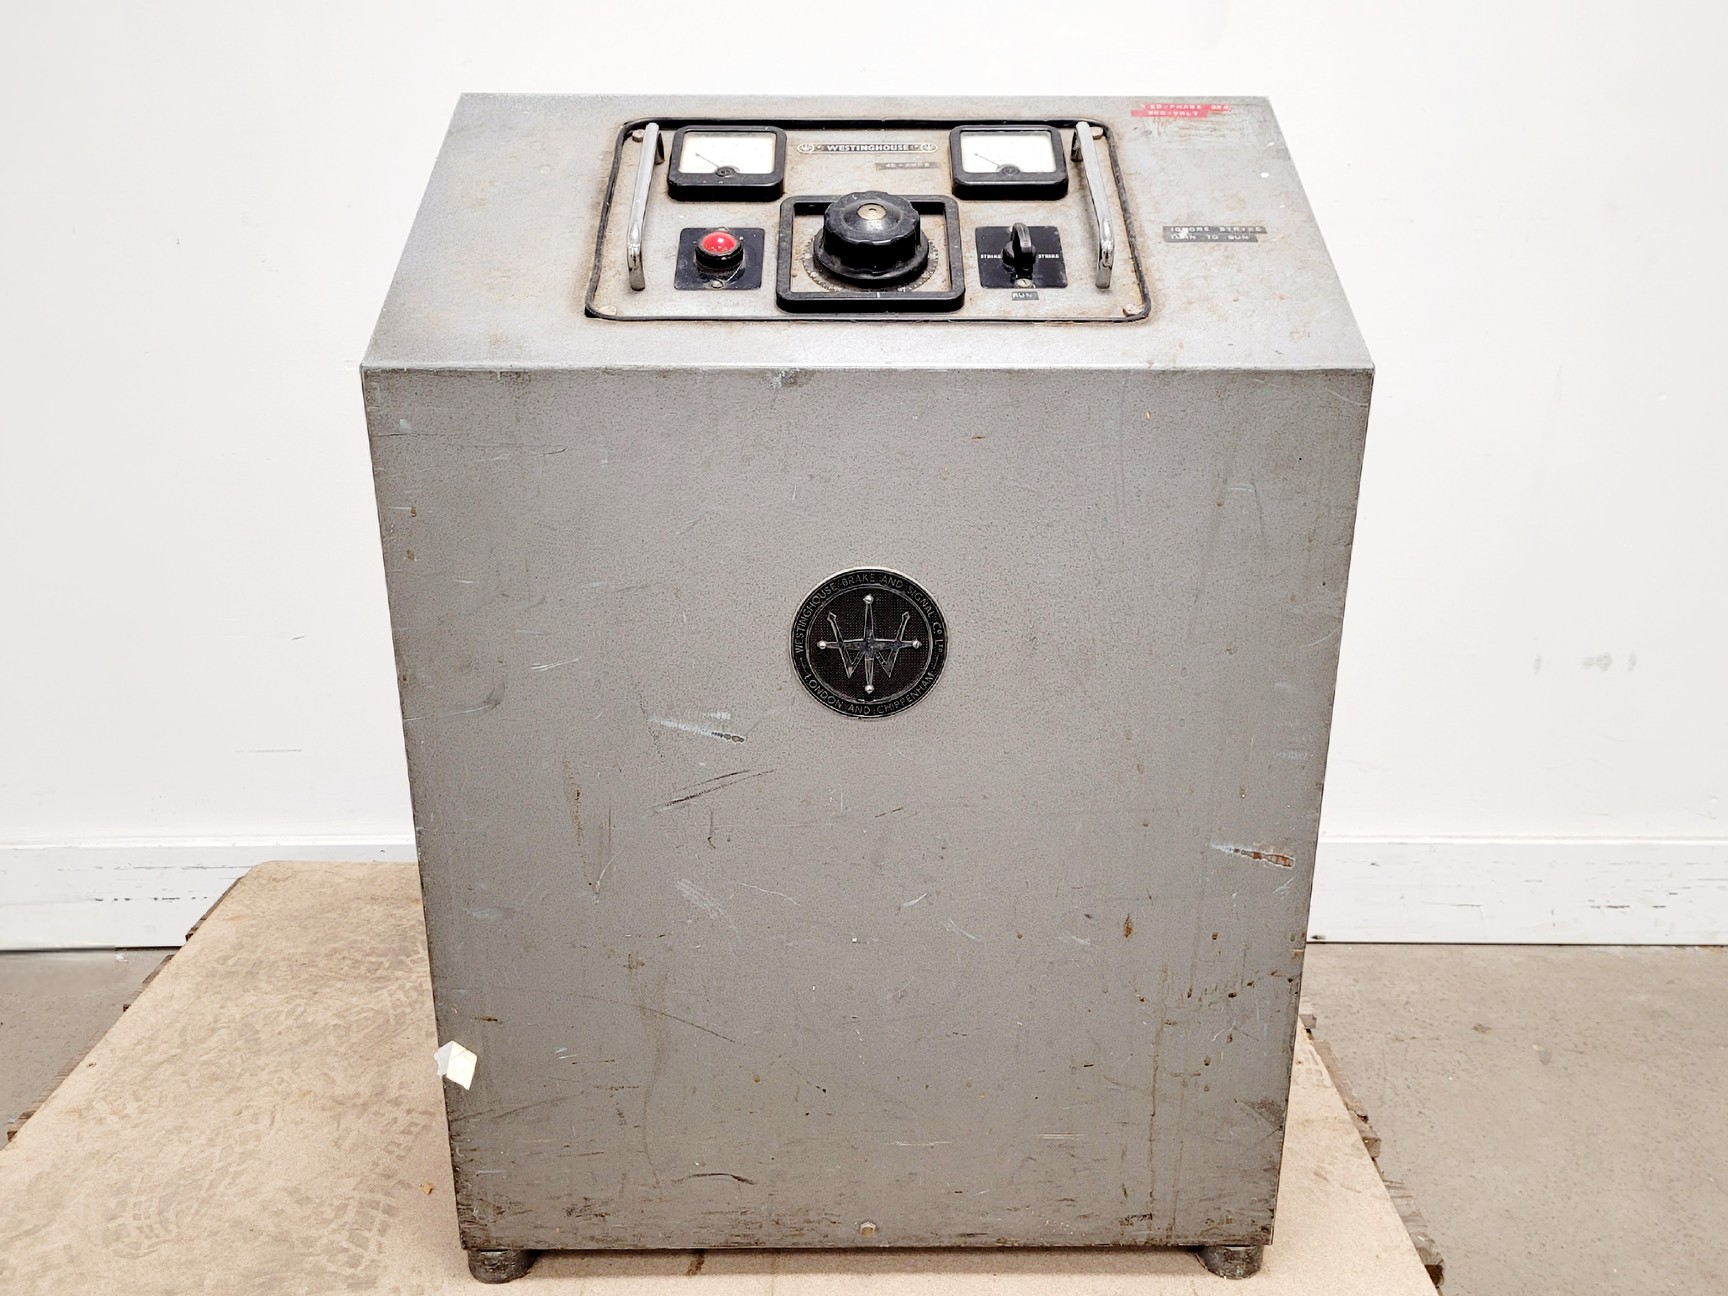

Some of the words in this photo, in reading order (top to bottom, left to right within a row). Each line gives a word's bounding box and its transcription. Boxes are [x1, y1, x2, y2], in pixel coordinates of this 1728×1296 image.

[794, 582, 841, 653] WESTINGHOUSE
[841, 573, 877, 587] BRAKE
[879, 573, 904, 588] AND
[906, 586, 936, 619] SIGNAL
[803, 673, 843, 710] LONDON
[847, 705, 871, 715] AND
[876, 671, 936, 715] CHIPPENHAM
